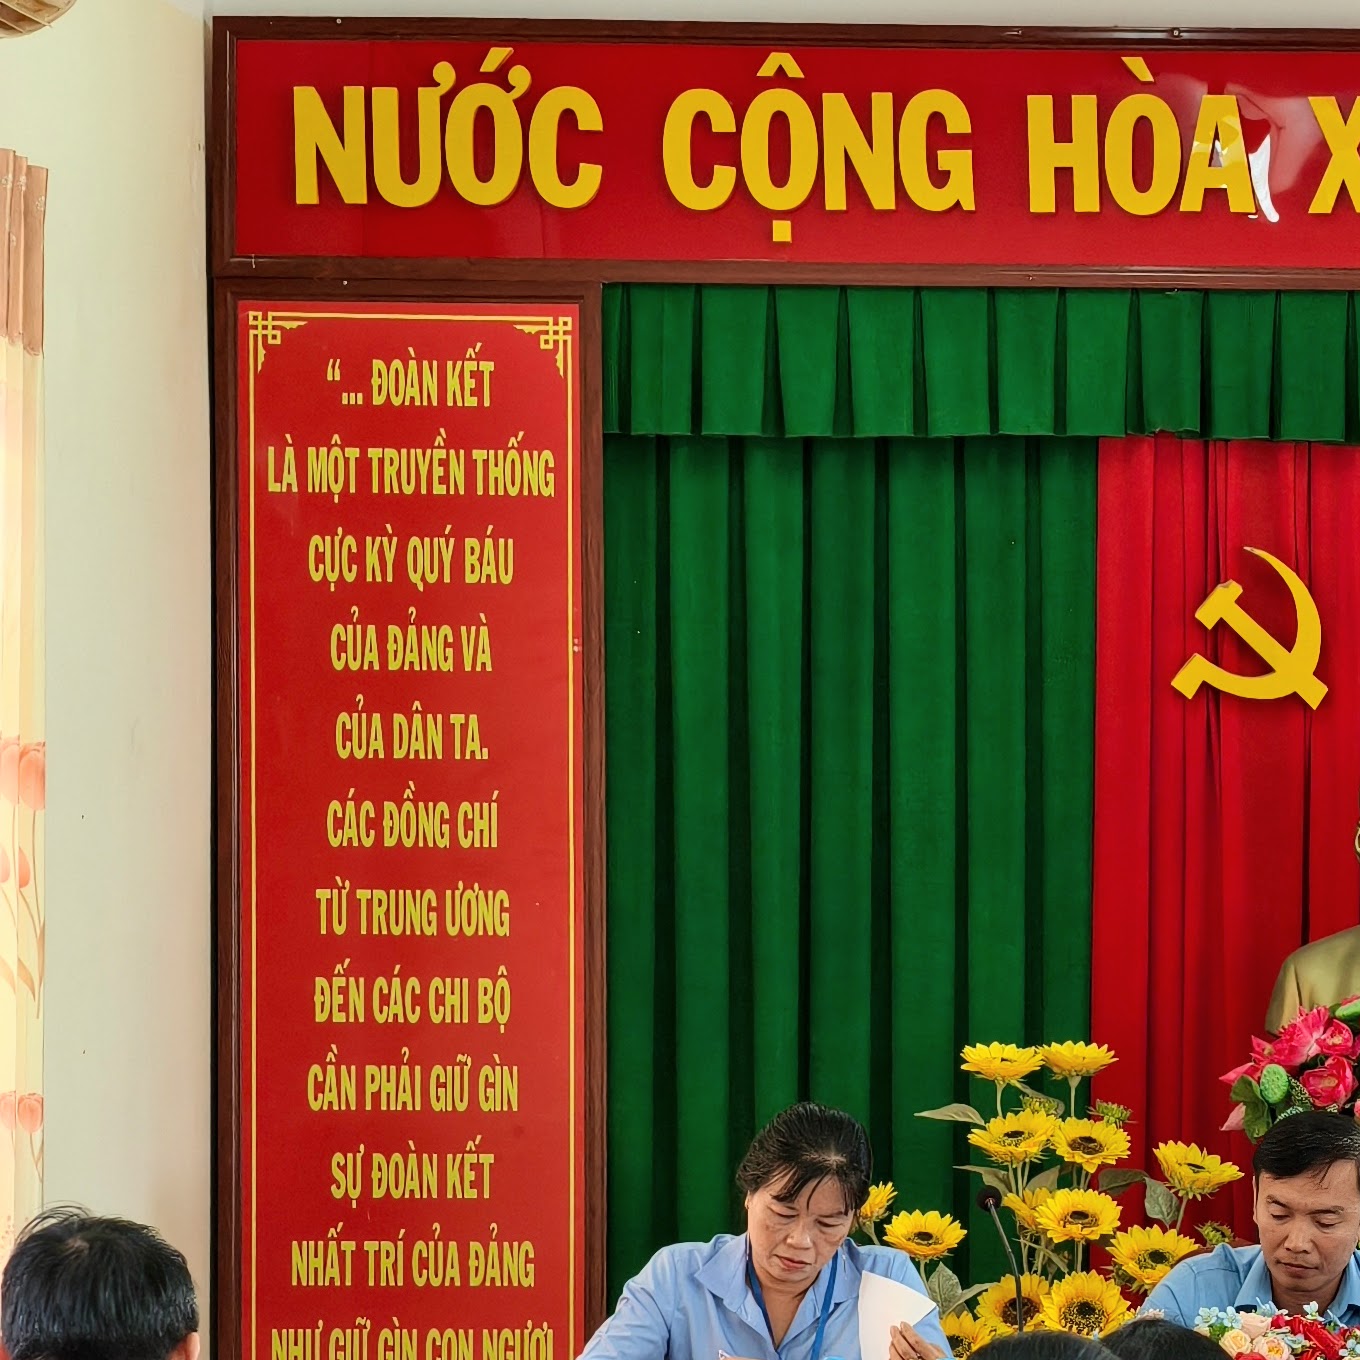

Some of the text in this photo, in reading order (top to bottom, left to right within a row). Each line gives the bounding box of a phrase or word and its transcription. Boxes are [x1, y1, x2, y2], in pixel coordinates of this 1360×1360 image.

[294, 48, 602, 208] NƯỚC
[663, 53, 975, 241] CỘNG
[1027, 57, 1255, 215] HÒA
[372, 347, 437, 406] ĐOÀN
[447, 343, 494, 406] KẾT
[268, 428, 554, 502] LÀ MỘT TRUYỀN THỐNG
[309, 524, 513, 591] CỰC KỲ QUÝ BÁU
[331, 606, 492, 671] CỦA ĐẢNG VÀ
[336, 694, 488, 759] CỦA DÂN TA.
[327, 781, 498, 848] CÁC ĐỒNG CHÍ
[316, 876, 509, 936] TỪ TRUNG ƯƠNG
[314, 959, 510, 1033] ĐẾN CÁC CHI BỘ
[308, 1045, 517, 1111] CẦN PHẢI GIỮ GÌN
[331, 1135, 494, 1208] SỰ ĐOÀN KẾT
[292, 1223, 534, 1287] NHẤT TRÍ CỦA ĐẢNG
